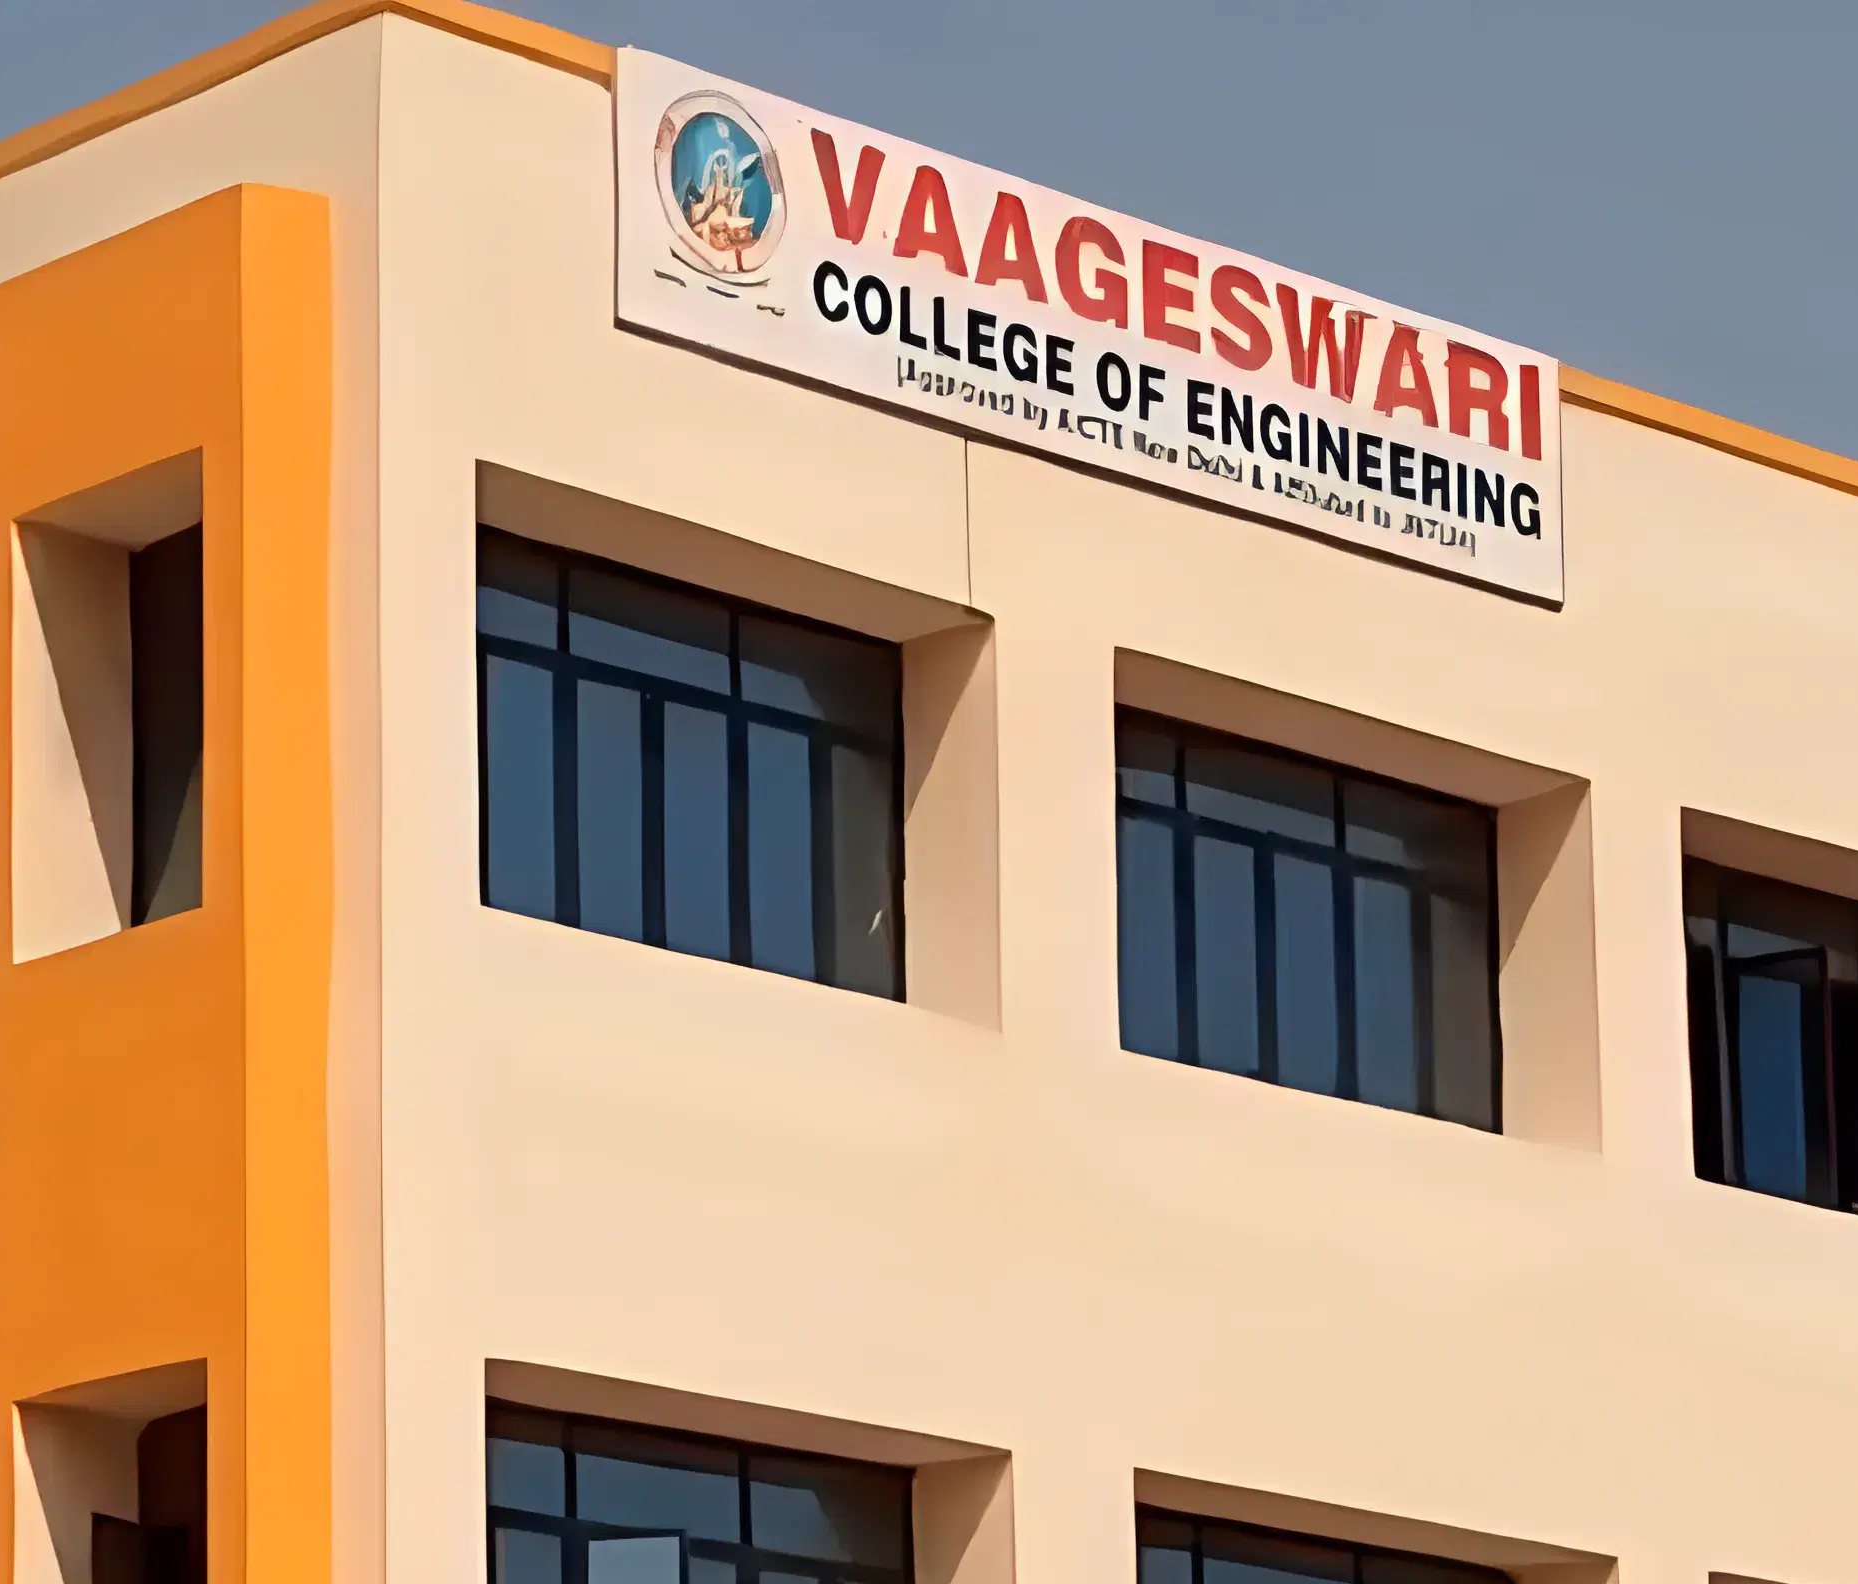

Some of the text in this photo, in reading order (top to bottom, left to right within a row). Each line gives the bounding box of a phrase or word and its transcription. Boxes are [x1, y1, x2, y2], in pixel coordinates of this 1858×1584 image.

[810, 128, 1542, 461] VAAGESWARI
[812, 259, 1075, 396] COLLEGE
[1096, 351, 1166, 422] OF
[1187, 378, 1543, 540] ENGINEERING
